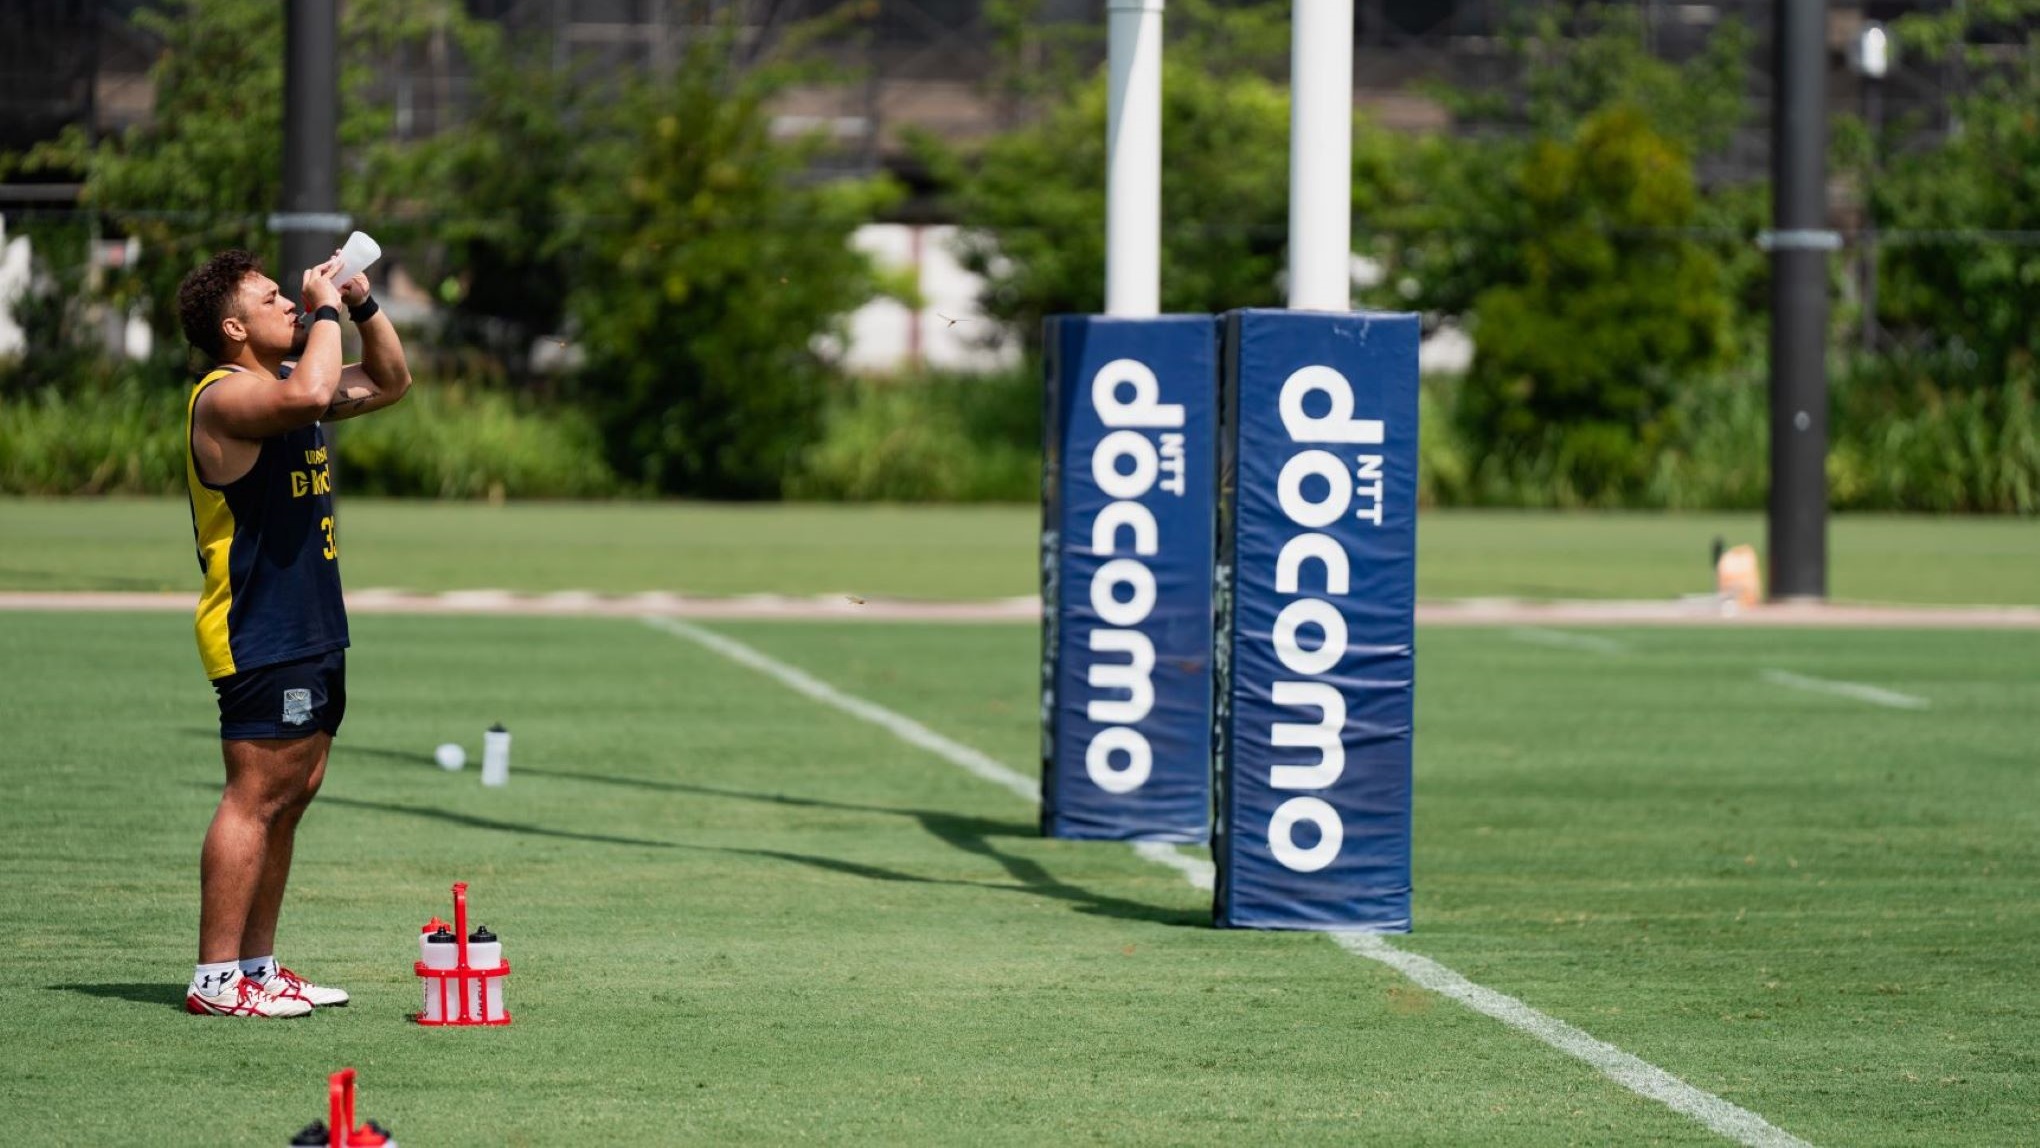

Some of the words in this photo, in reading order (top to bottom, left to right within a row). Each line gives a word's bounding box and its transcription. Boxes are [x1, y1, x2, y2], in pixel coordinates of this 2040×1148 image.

[1085, 358, 1186, 795] docomo
[1160, 433, 1185, 496] NTT
[1356, 454, 1384, 526] NTT
[1267, 365, 1385, 872] docomo
